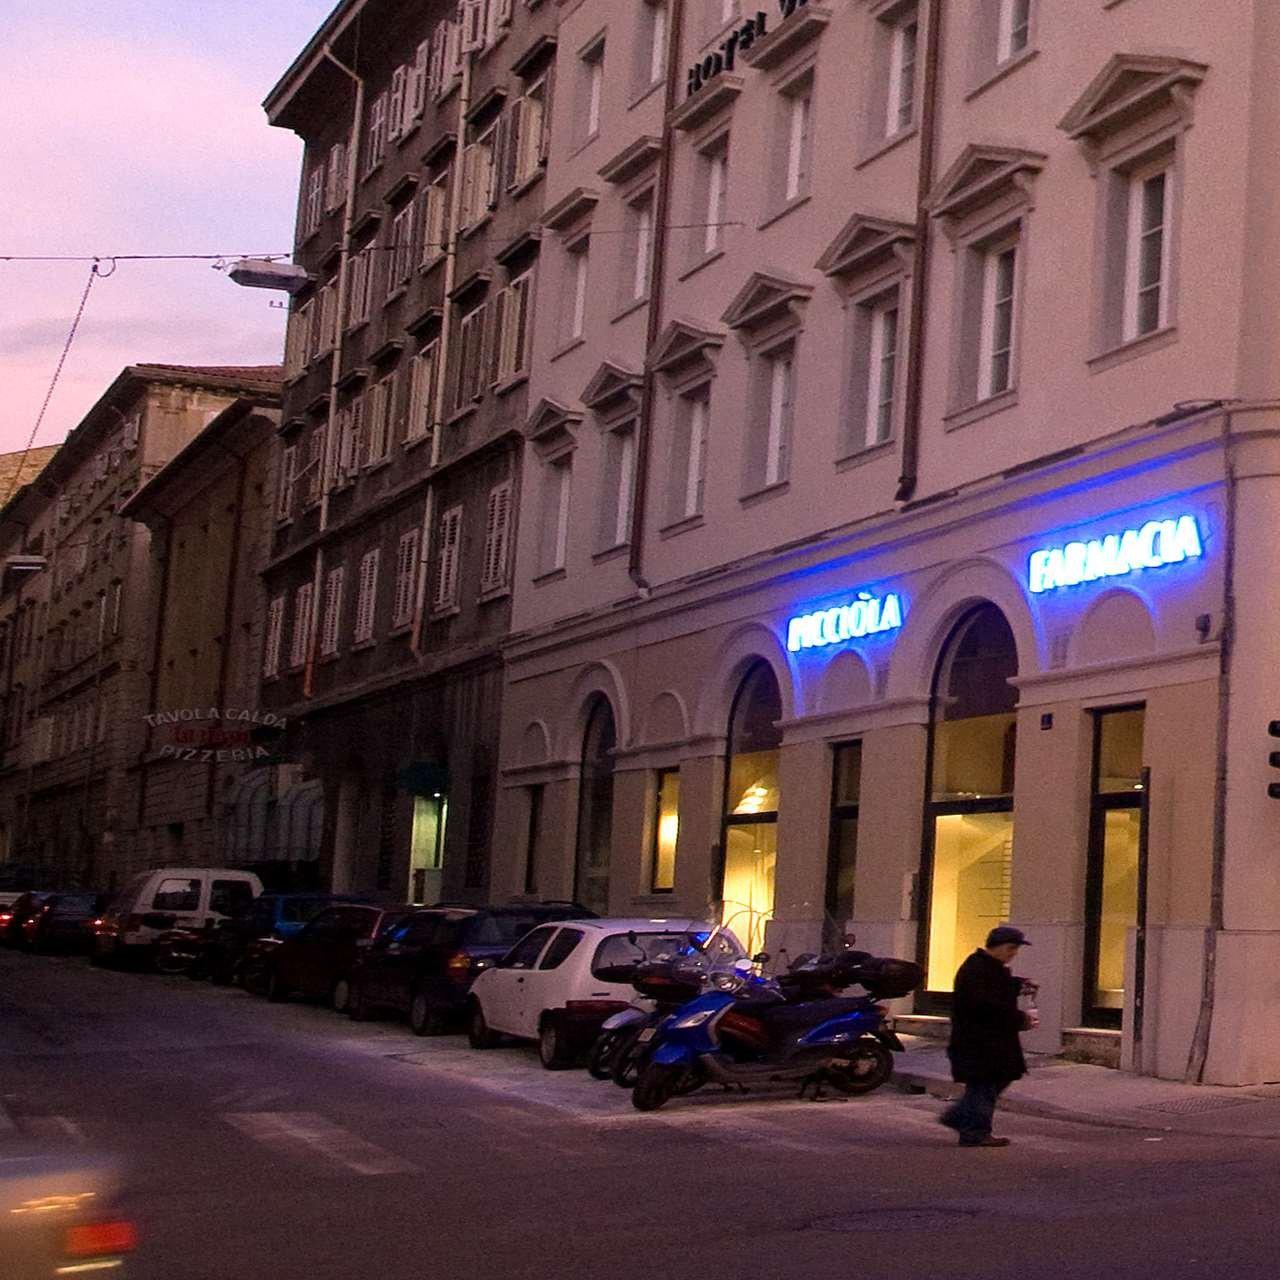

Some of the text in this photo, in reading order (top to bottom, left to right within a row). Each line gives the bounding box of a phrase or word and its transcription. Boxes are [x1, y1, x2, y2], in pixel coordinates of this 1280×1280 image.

[686, 11, 768, 98] HOTEL
[1029, 514, 1202, 593] FARMACIA
[142, 708, 287, 730] TAVOLA CALDA
[159, 745, 270, 762] PIZZERIA
